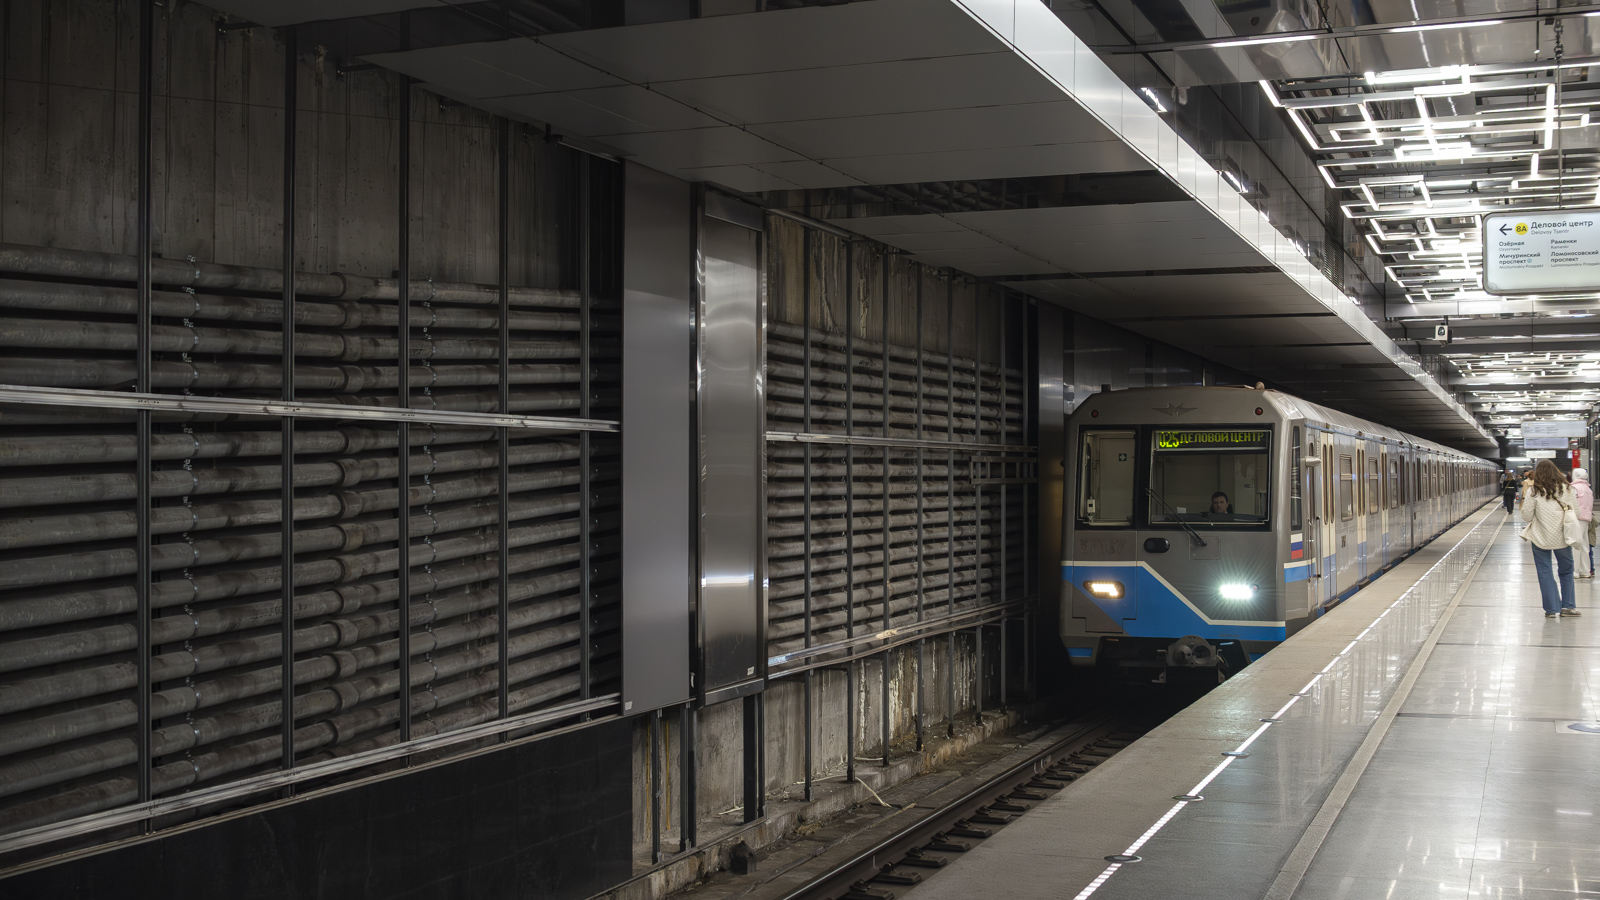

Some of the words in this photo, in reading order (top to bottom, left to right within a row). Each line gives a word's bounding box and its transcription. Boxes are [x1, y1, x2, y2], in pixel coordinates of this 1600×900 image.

[1531, 221, 1567, 229] Деловой
[1180, 432, 1229, 443] ДЕЛОВОЙ
[1230, 432, 1264, 442] ЦЕНТР
